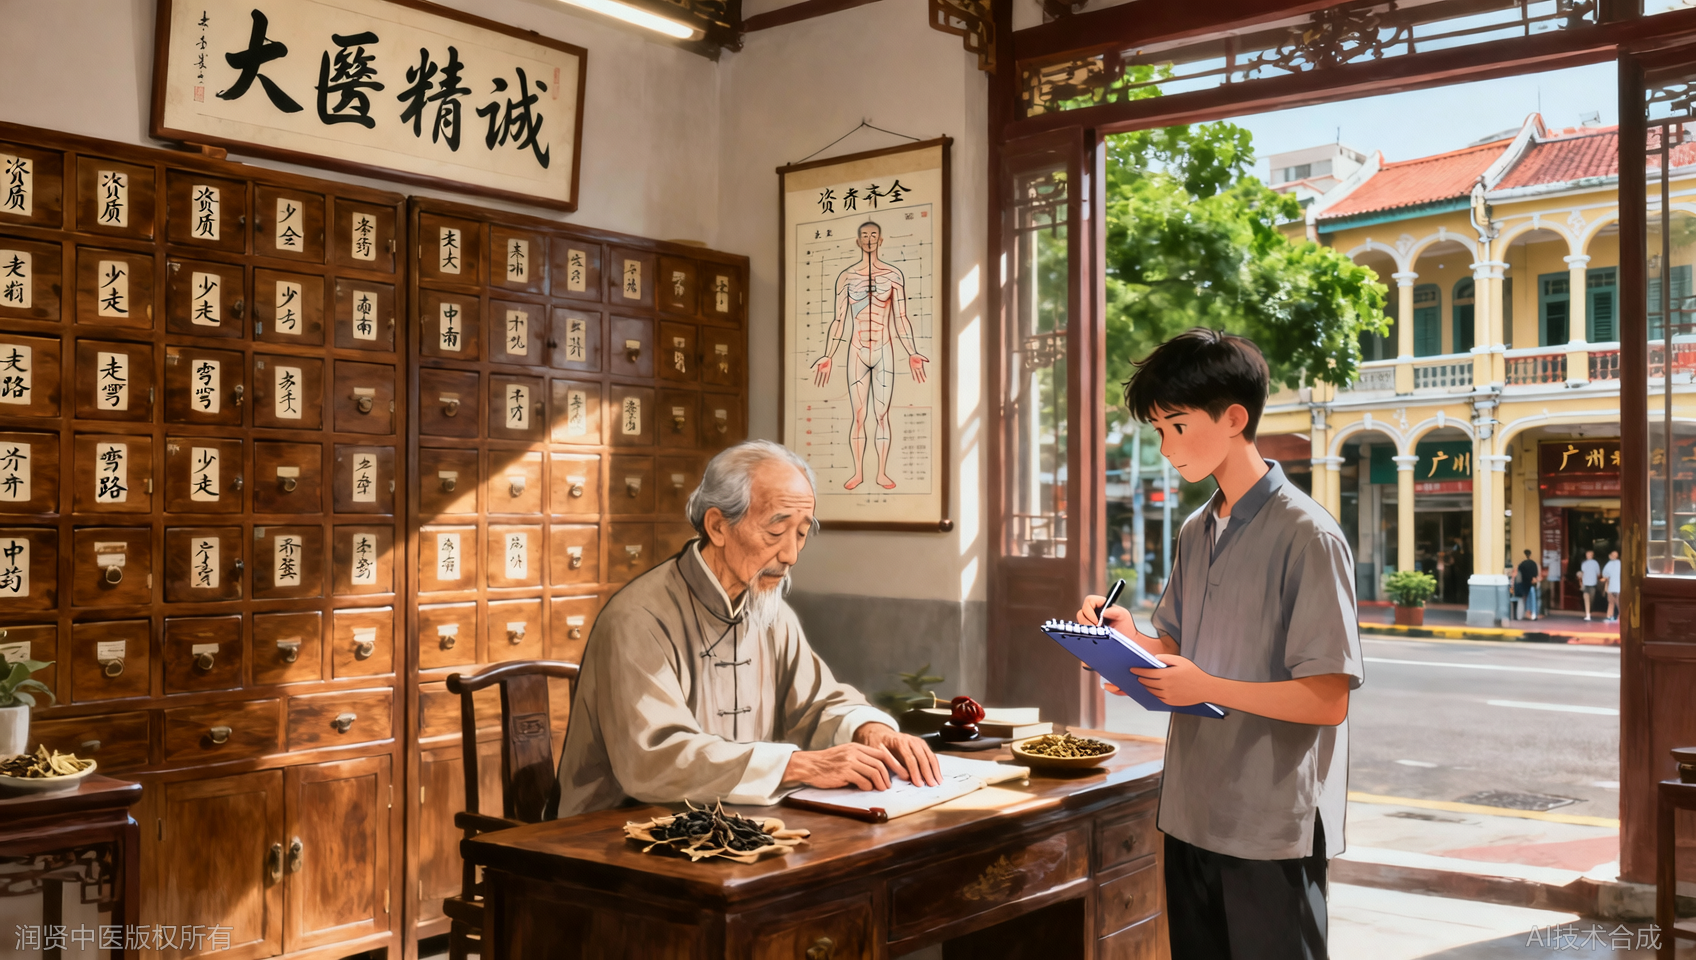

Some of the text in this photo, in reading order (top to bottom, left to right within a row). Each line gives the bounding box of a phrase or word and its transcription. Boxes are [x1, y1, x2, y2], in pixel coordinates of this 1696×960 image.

[4, 157, 31, 211] 资质
[100, 172, 126, 223] 资质
[193, 186, 219, 237] 资质
[101, 264, 129, 313] 少走
[194, 275, 220, 323] 少走
[193, 449, 220, 497] 少走
